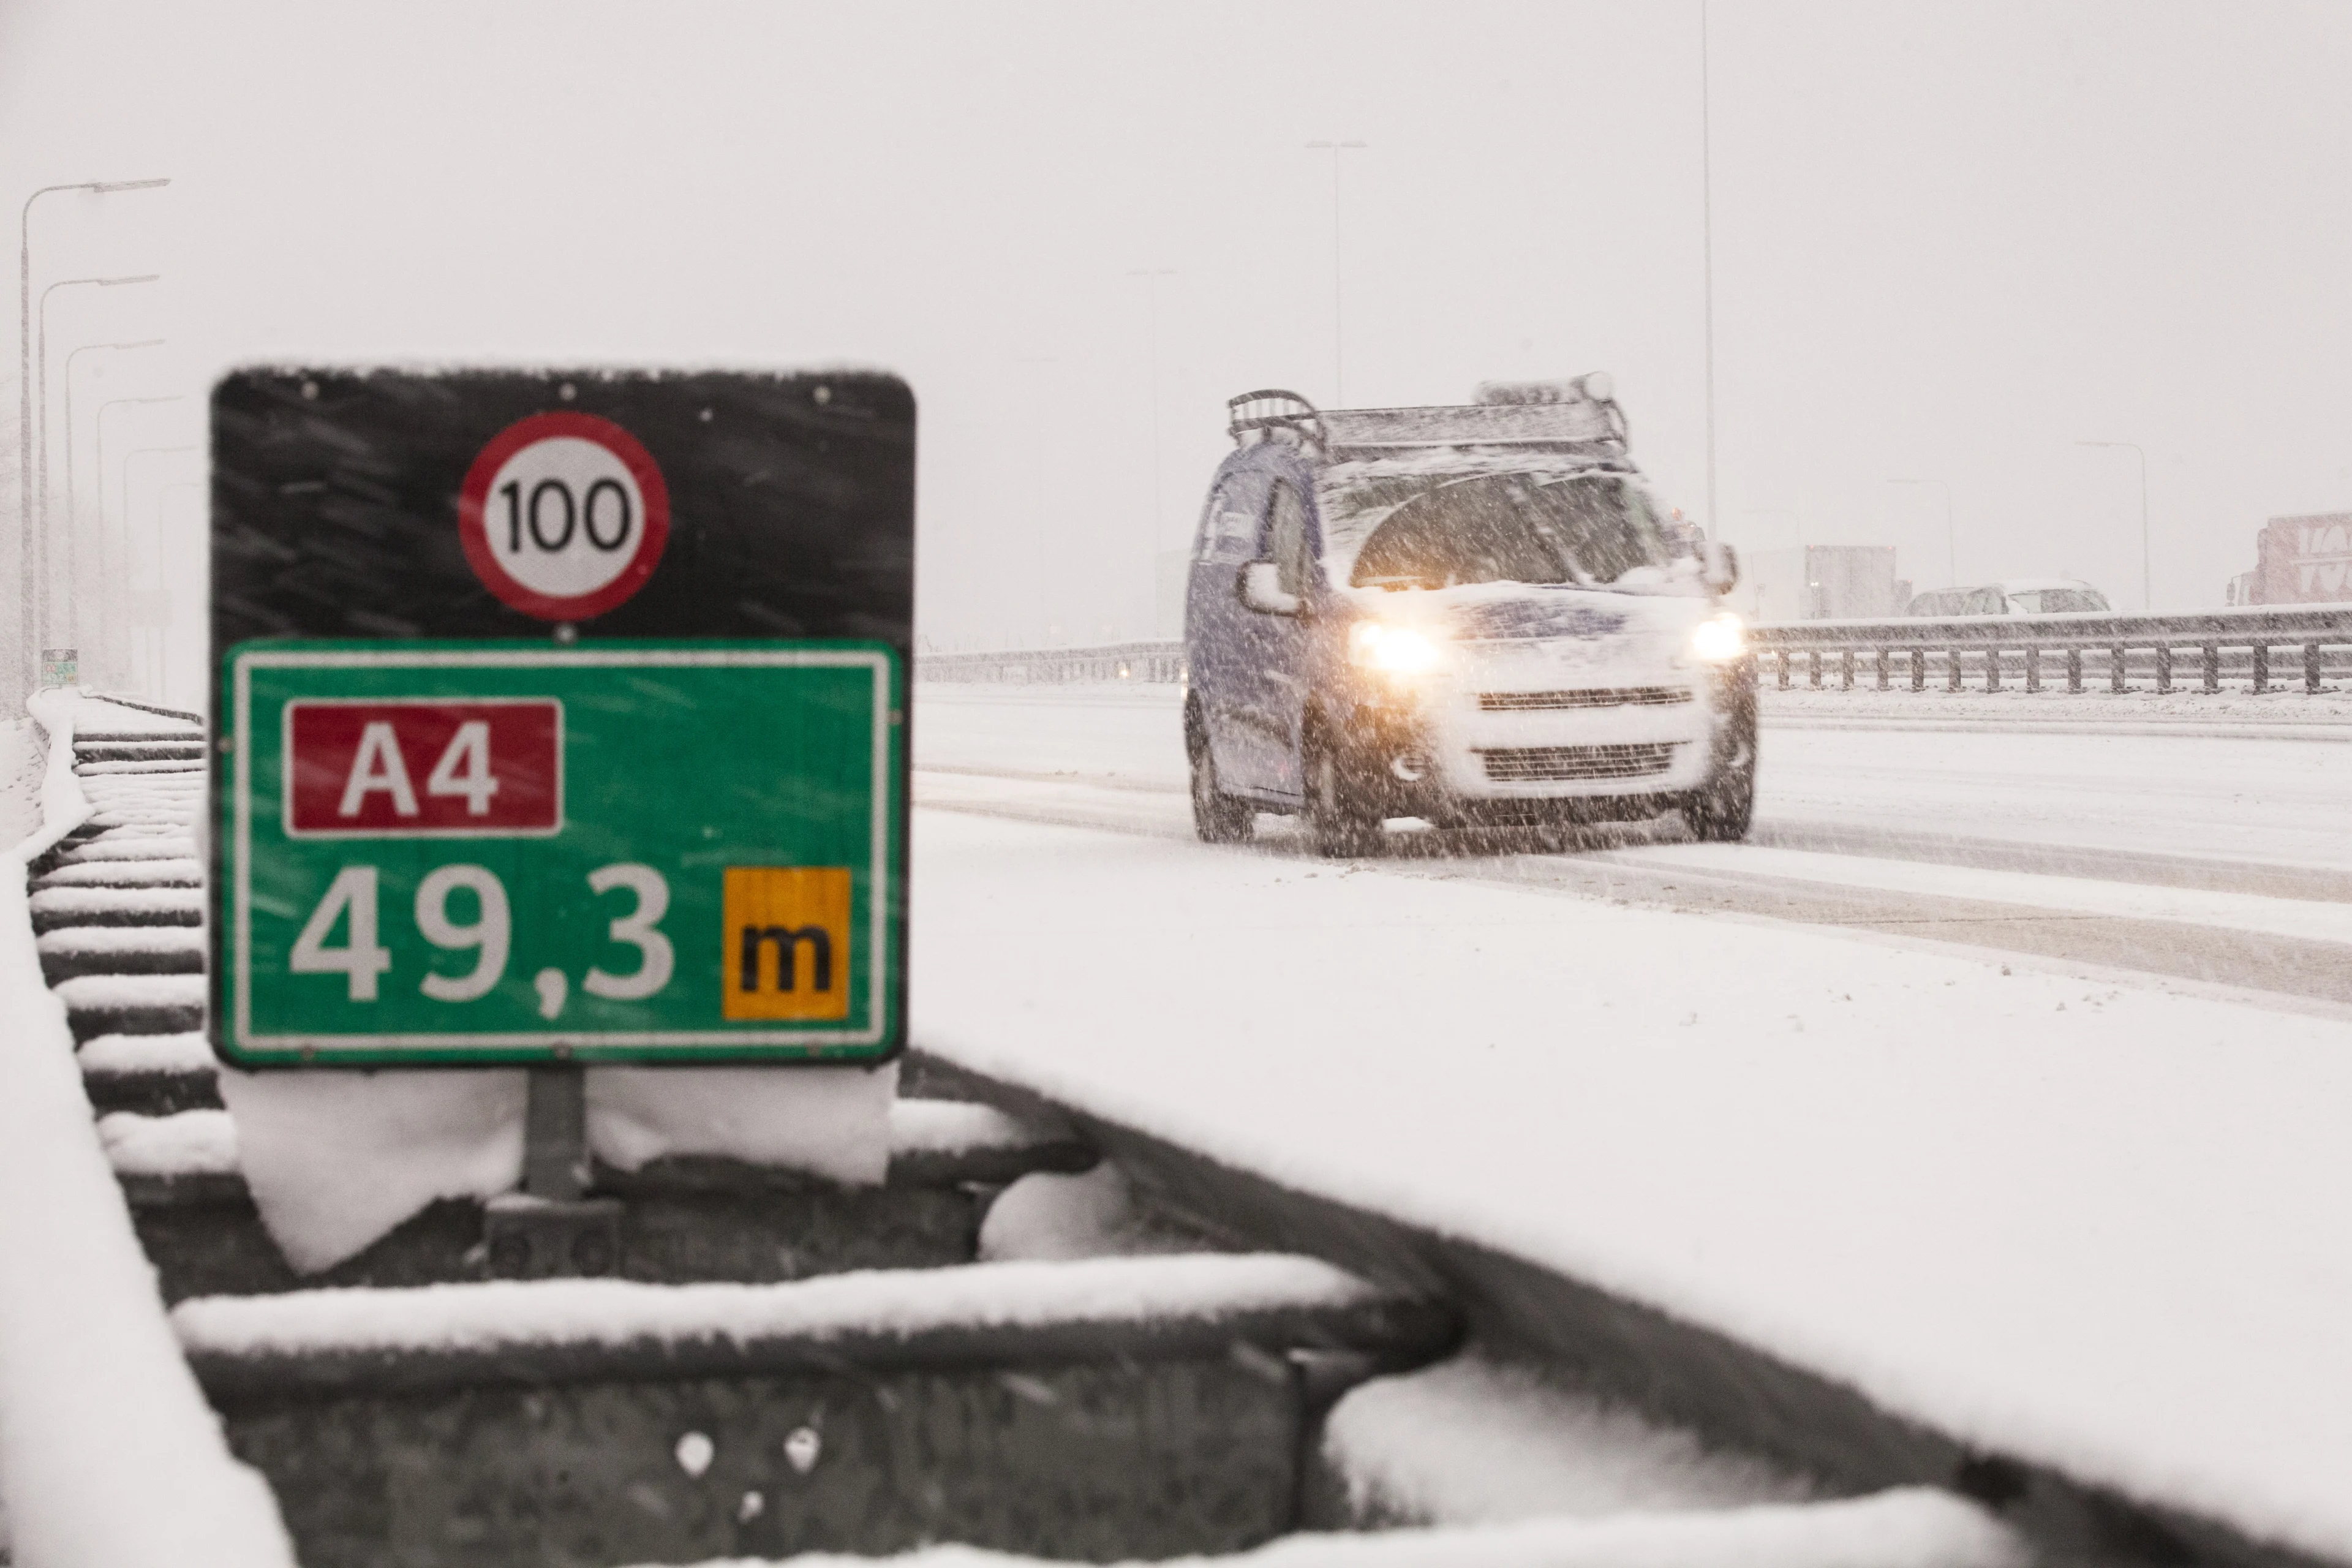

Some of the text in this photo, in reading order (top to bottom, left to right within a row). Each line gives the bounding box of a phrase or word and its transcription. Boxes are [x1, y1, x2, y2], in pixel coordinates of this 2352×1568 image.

[499, 477, 633, 554] 100
[338, 721, 500, 816] A4
[289, 862, 675, 1020] 49,3
[739, 924, 834, 994] m
